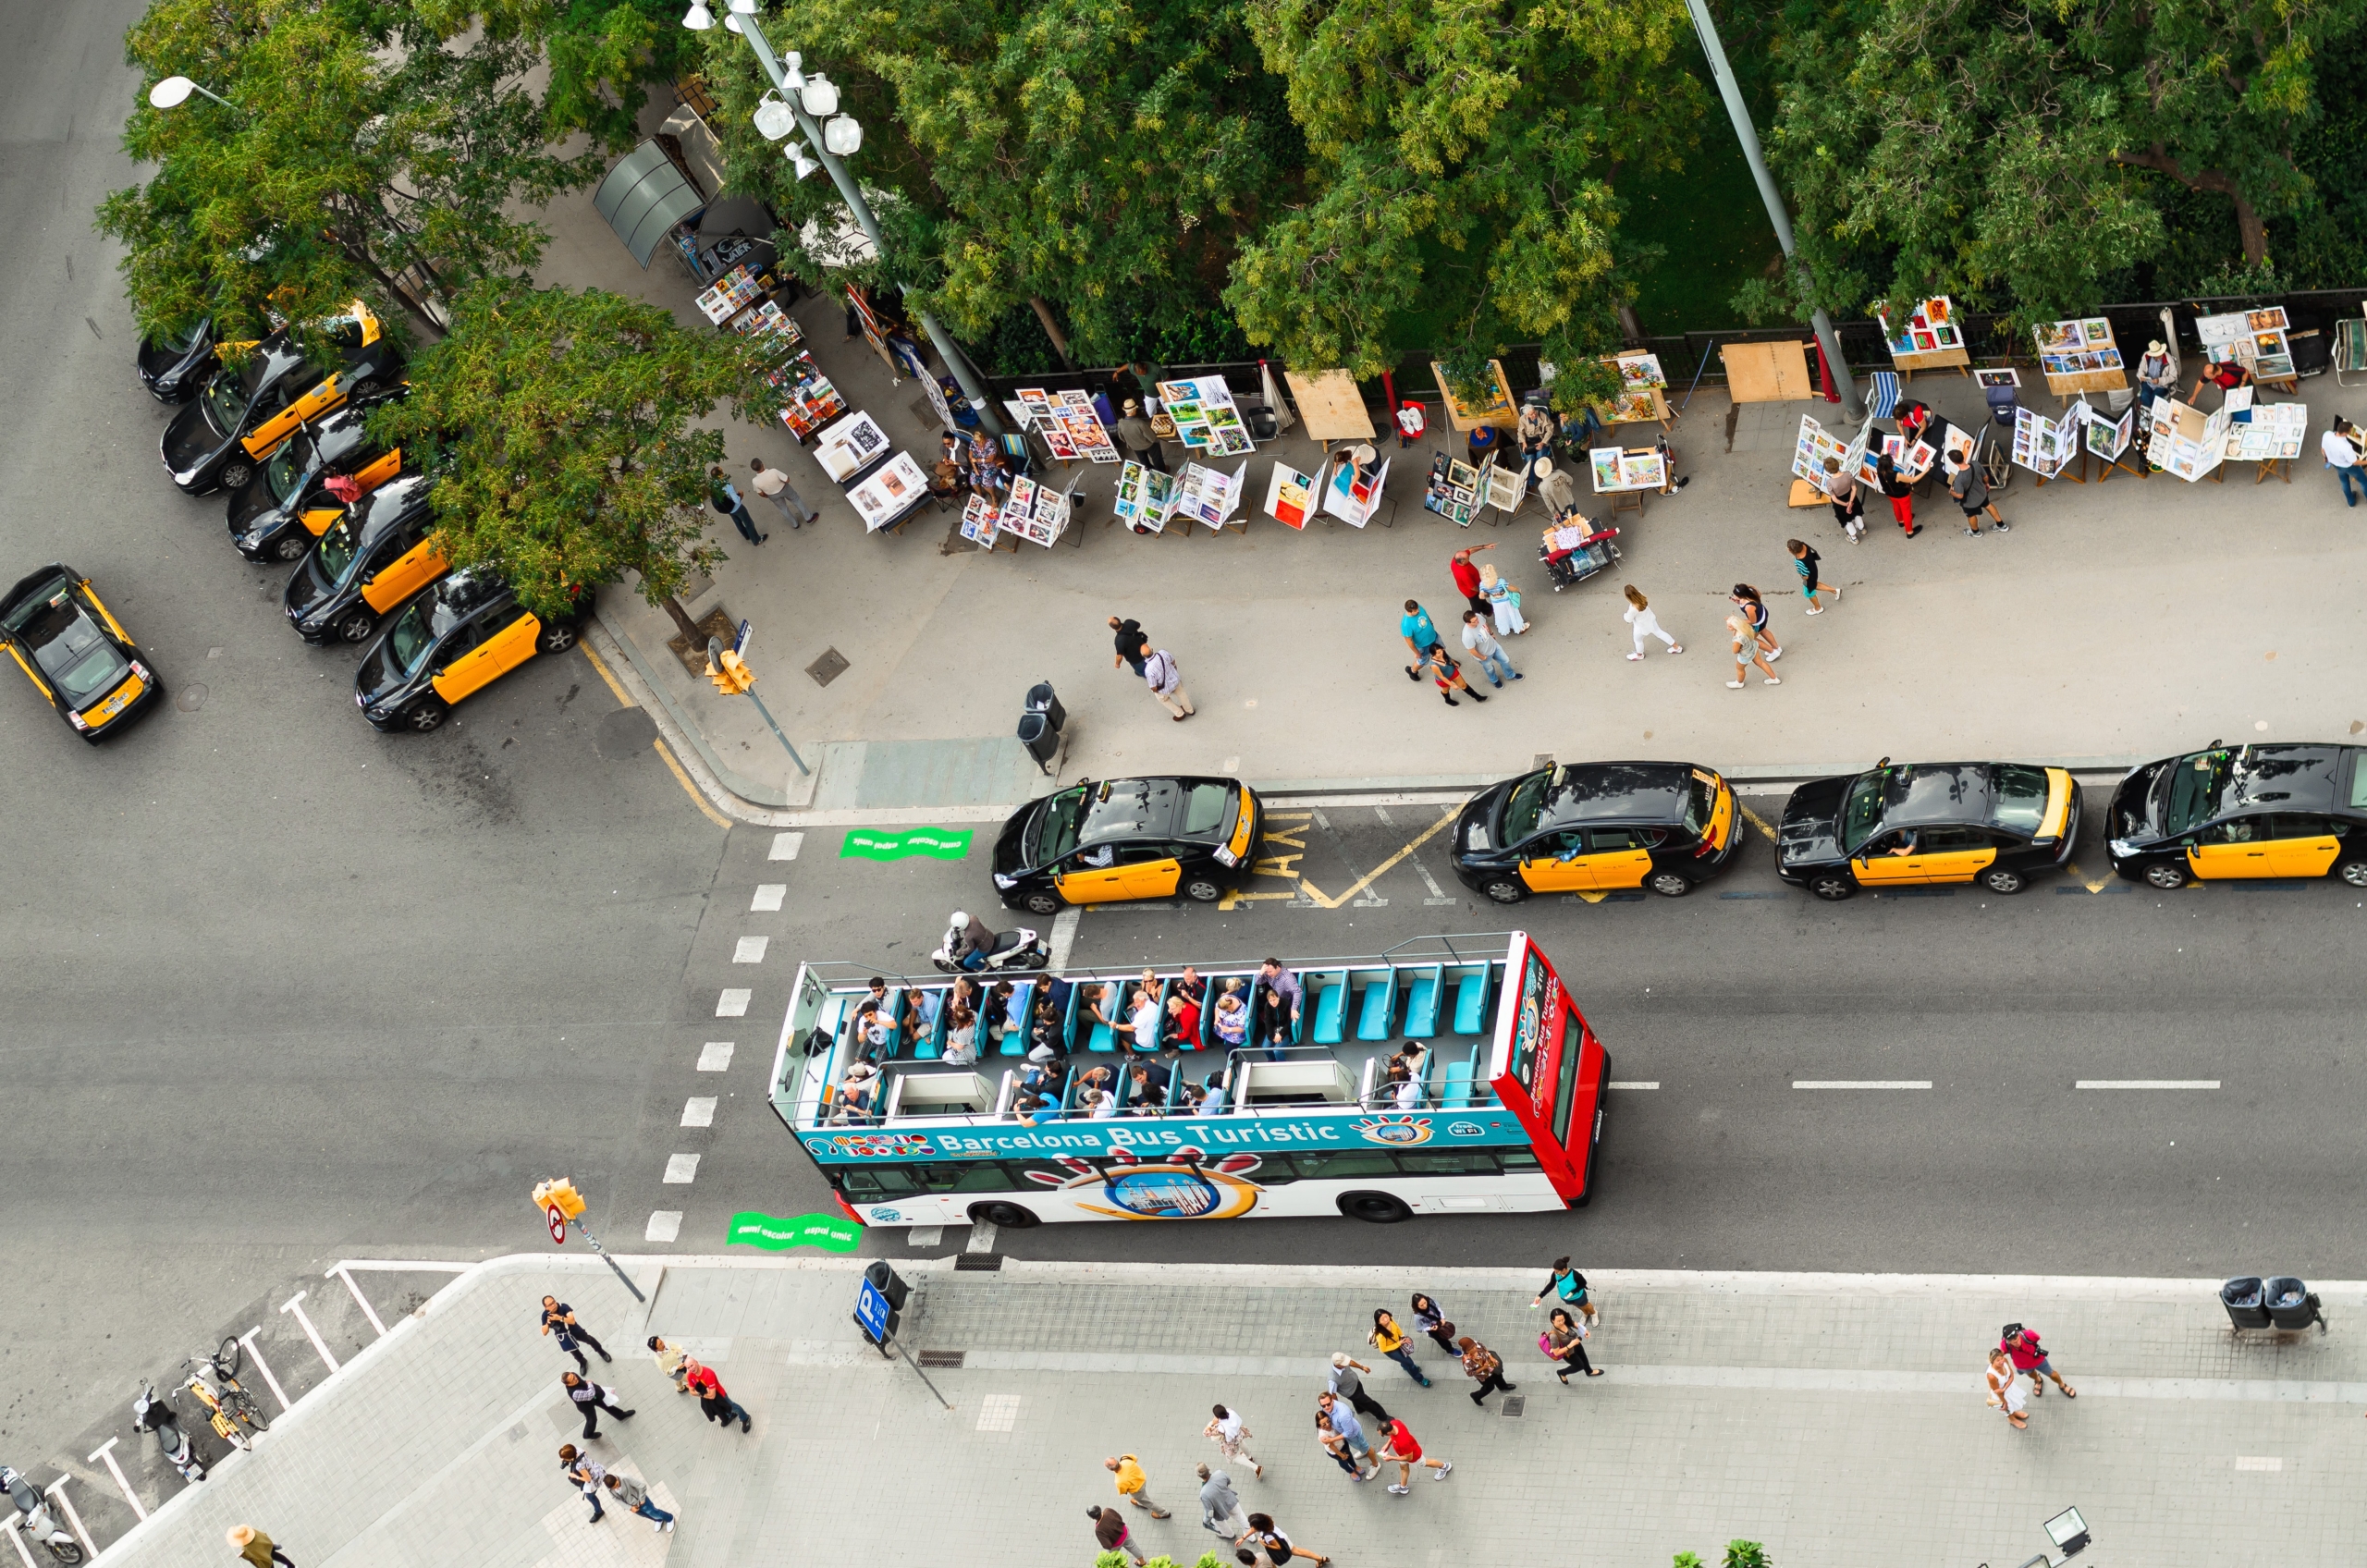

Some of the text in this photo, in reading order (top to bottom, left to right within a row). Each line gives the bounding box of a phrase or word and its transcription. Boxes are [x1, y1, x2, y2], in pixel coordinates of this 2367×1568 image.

[722, 242, 752, 263] WATER
[1530, 1051, 1542, 1102] Barcelona
[1537, 1024, 1546, 1047] Bus
[935, 1121, 1341, 1151] Barcelona Bus Turístic
[859, 1289, 875, 1323] P
